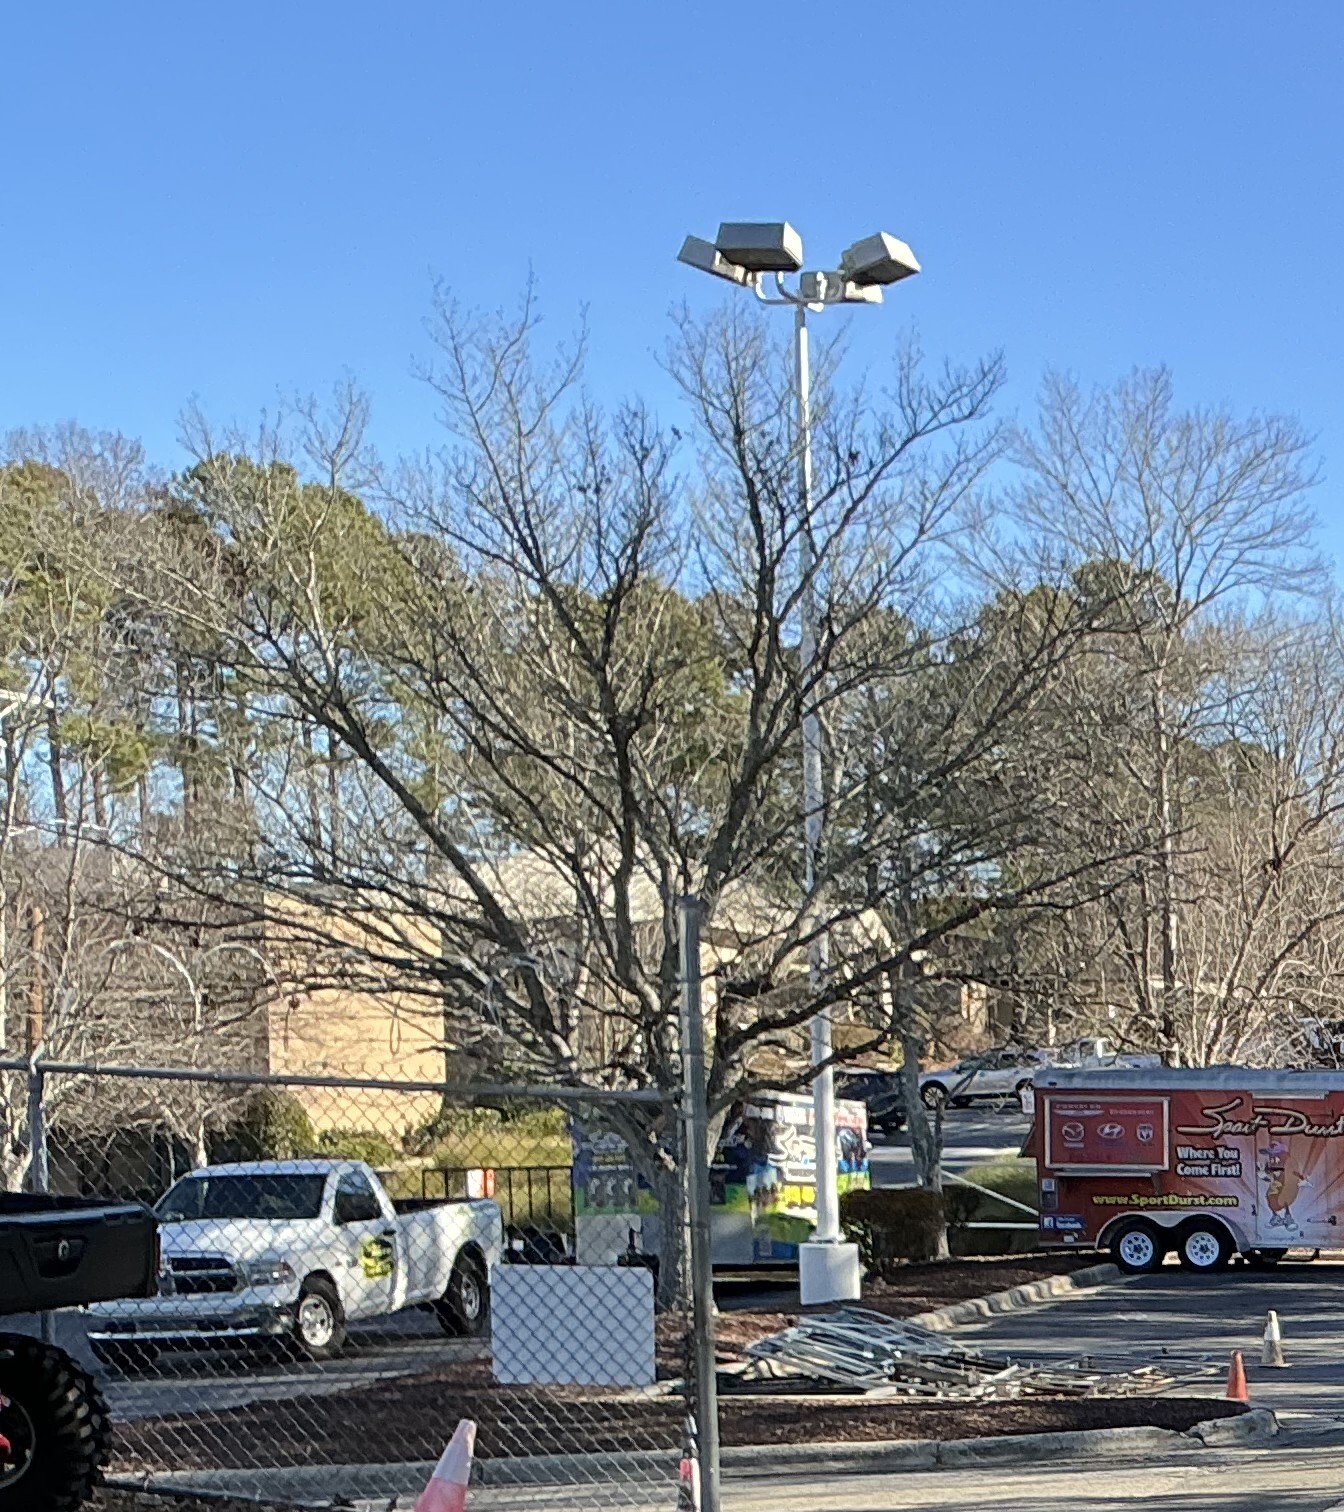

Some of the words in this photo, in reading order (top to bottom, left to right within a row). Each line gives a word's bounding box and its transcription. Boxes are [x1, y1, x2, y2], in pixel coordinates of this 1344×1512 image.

[1176, 1146, 1215, 1160] Where
[1215, 1146, 1239, 1160] You
[1176, 1163, 1210, 1176] Come
[1210, 1163, 1241, 1176] First!
[1092, 1193, 1238, 1207] www.SportDurst.com
